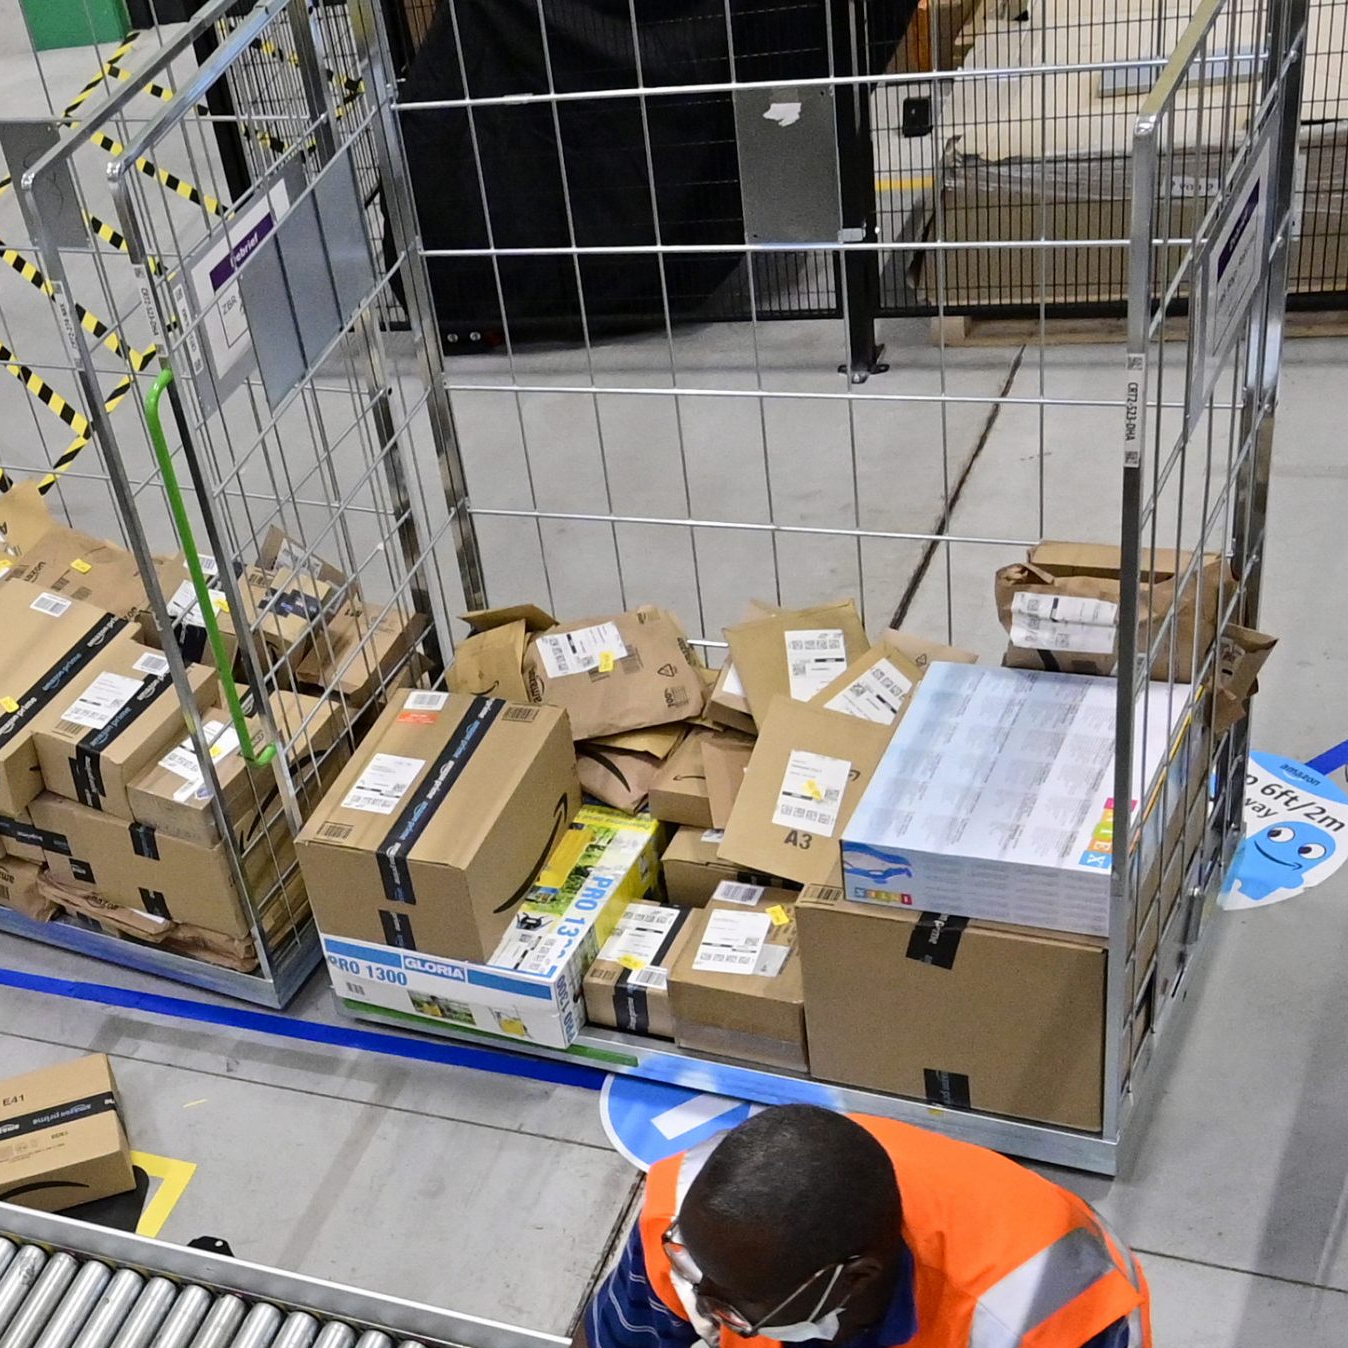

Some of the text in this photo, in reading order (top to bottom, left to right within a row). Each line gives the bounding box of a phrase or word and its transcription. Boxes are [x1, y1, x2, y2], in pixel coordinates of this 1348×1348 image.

[1126, 382, 1139, 441] CRT2-523-DHA
[1279, 763, 1322, 788] amazon
[1259, 782, 1347, 833] 6ft/2m
[784, 831, 813, 850] A3
[573, 874, 615, 912] PRO
[366, 959, 409, 988] 1300
[404, 956, 466, 980] GLORIA
[2, 1093, 25, 1107] E41
